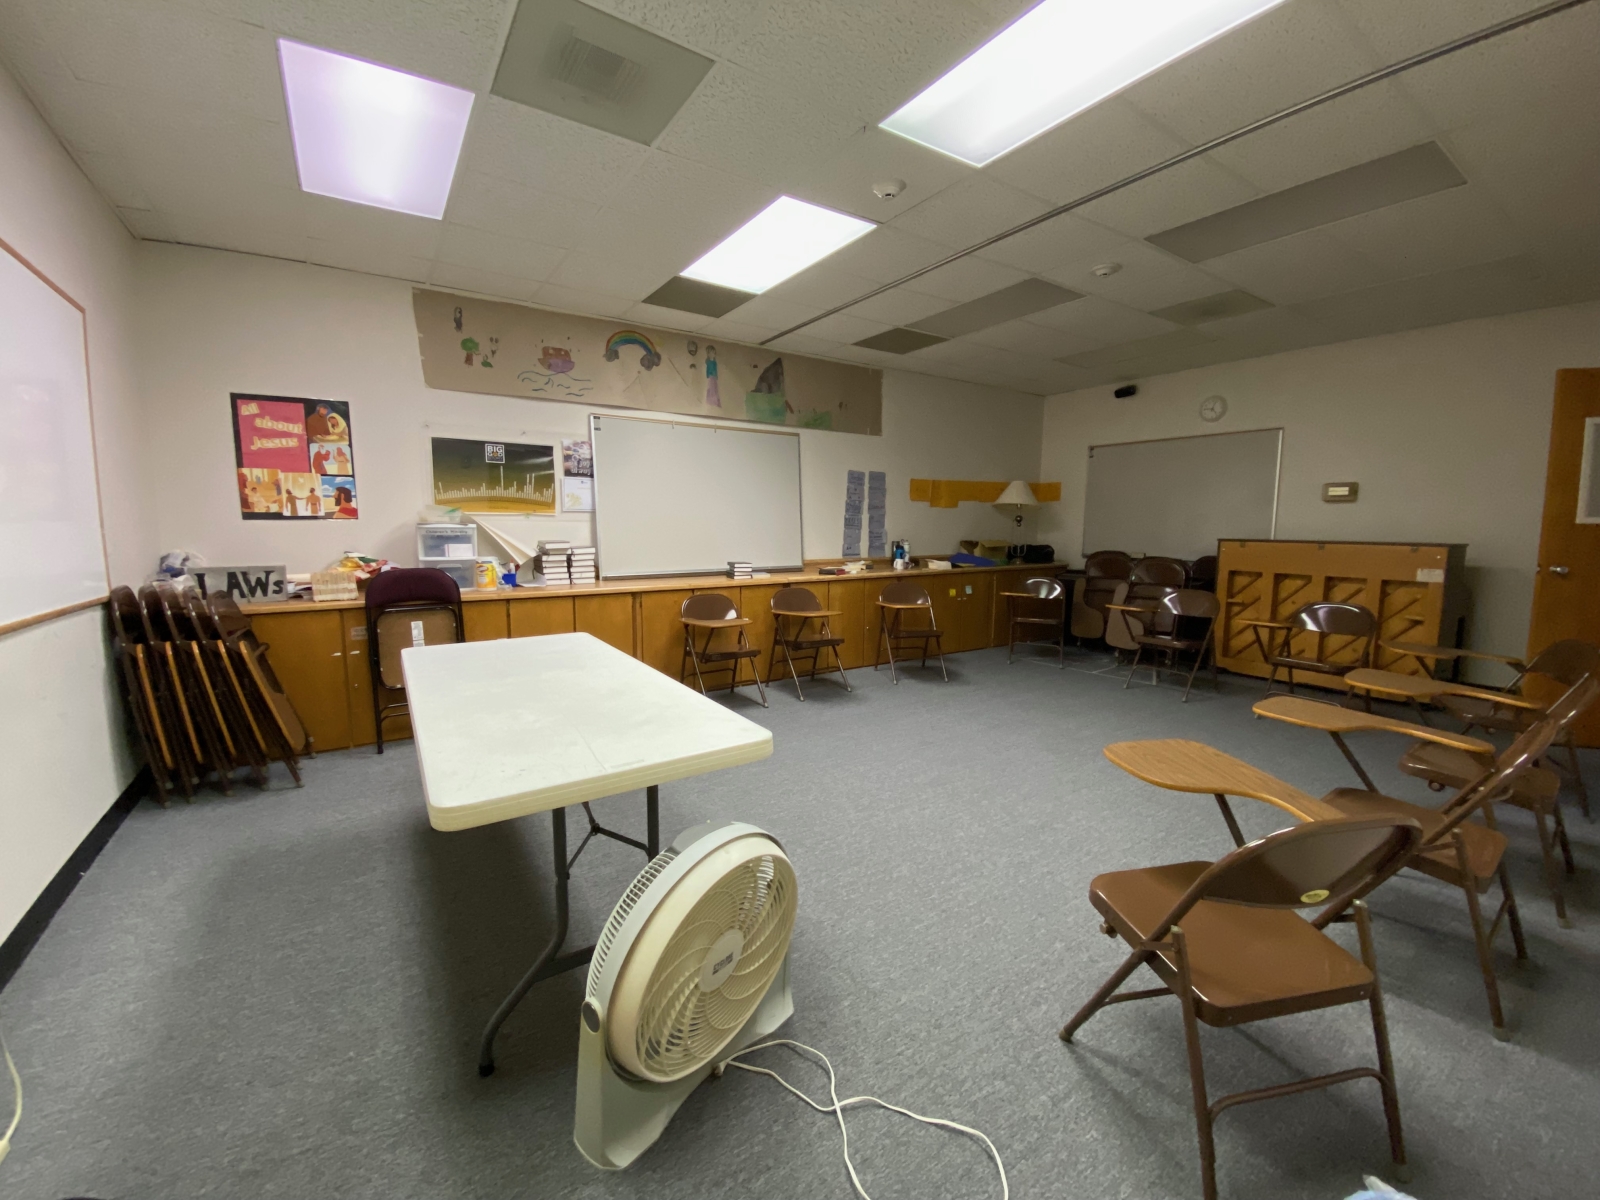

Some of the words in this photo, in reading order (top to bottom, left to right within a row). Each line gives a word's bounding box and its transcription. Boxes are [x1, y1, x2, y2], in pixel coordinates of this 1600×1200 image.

[255, 416, 302, 434] about
[250, 436, 299, 450] Jesus
[487, 445, 503, 453] BIG
